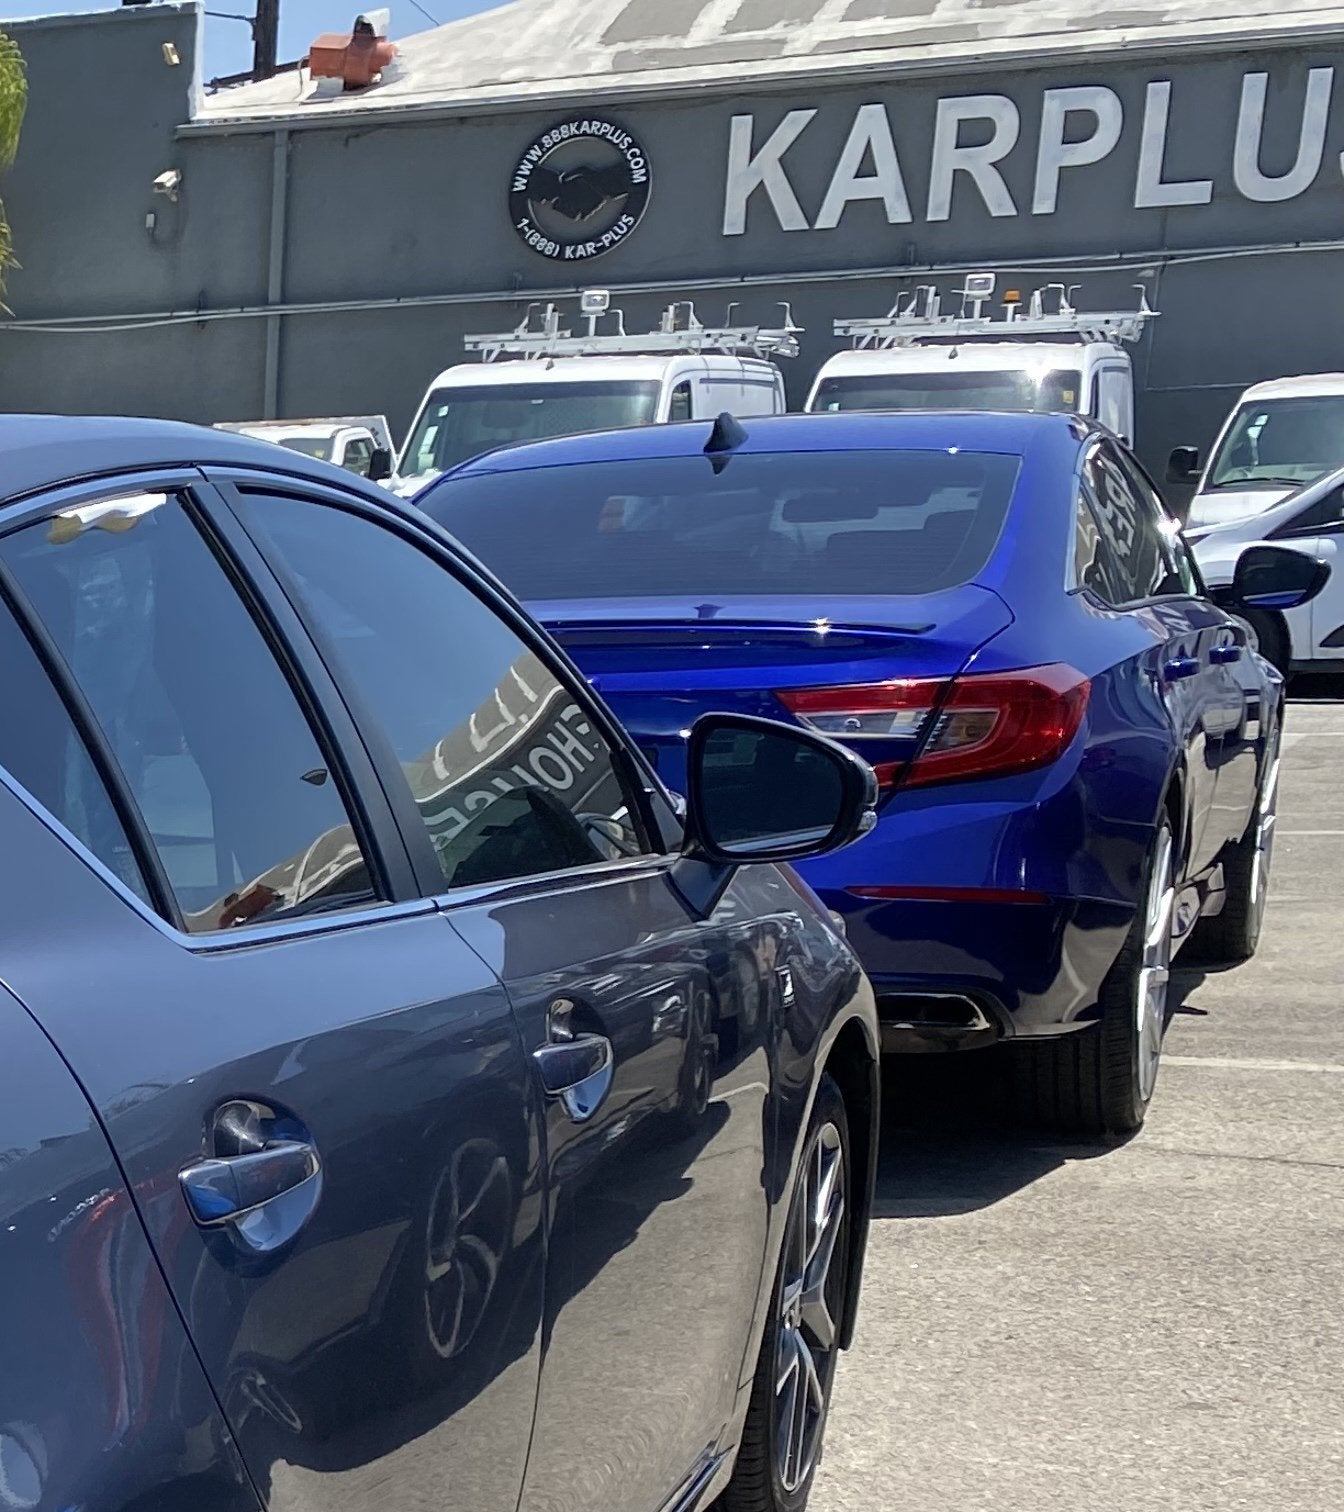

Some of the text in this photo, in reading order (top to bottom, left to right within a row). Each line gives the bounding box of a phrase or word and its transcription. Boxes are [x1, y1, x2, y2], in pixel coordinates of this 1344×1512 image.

[512, 120, 647, 192] WWW.888KARPLUS.COM
[722, 66, 1344, 235] KARPLU
[516, 214, 635, 259] 1-(888) KAR-PLUS
